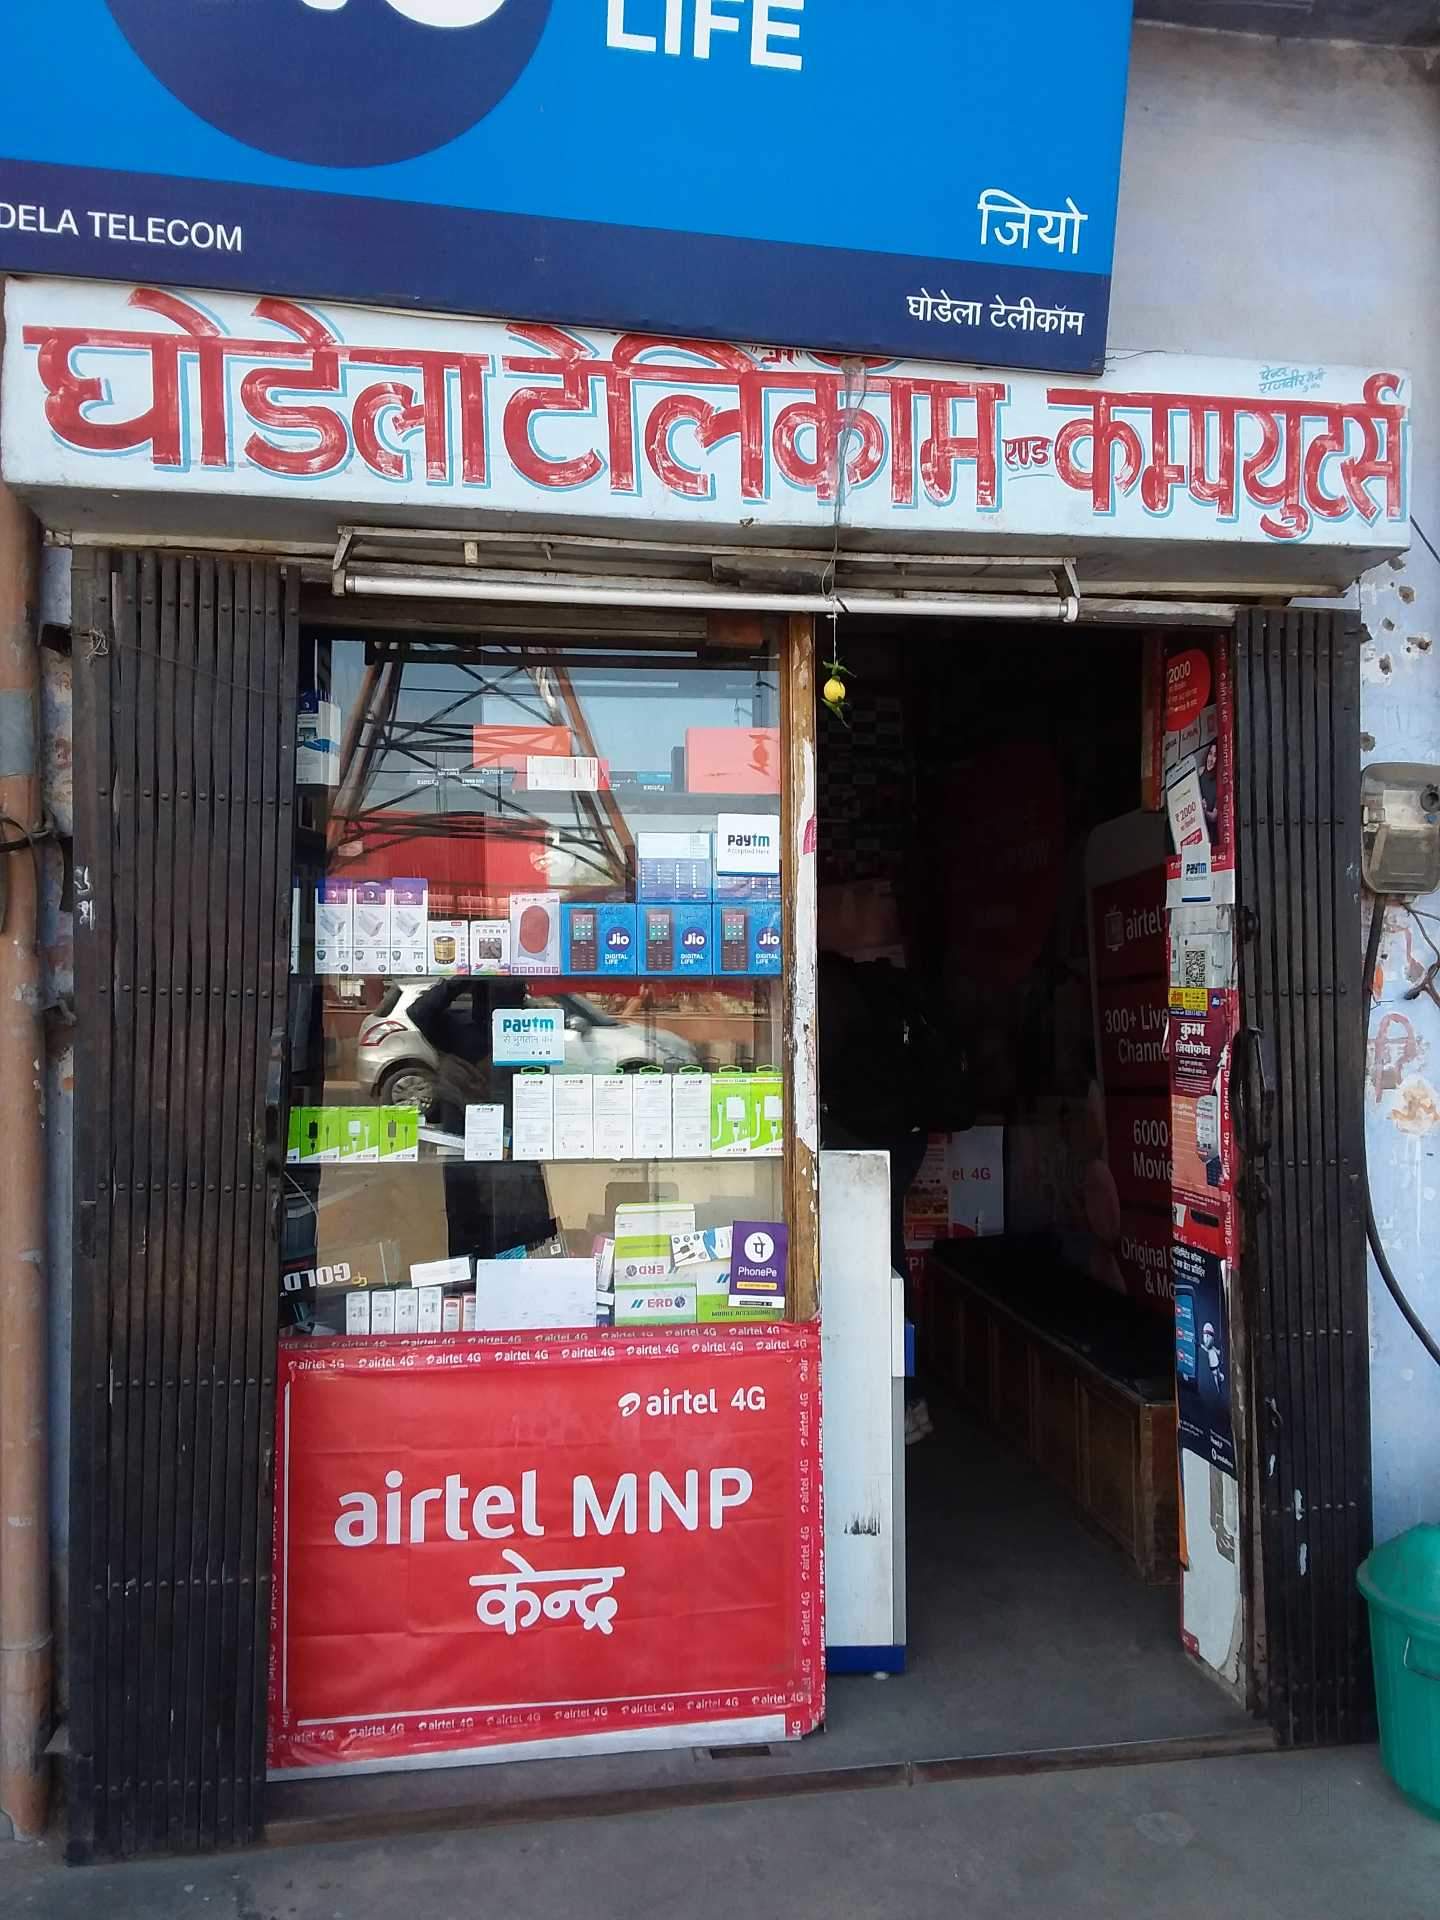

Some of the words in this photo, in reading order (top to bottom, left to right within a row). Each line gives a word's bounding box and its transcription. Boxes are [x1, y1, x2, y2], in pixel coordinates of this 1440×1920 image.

[605, 0, 803, 71] LIFE
[977, 188, 1089, 255] जियो
[87, 211, 242, 252] TELECOM
[906, 287, 983, 327] घोडेला
[989, 294, 1085, 336] टेलीकॉम
[1125, 905, 1162, 941] airtel
[608, 933, 630, 946] Jio
[684, 933, 705, 946] Jio
[759, 933, 780, 946] Jio
[1104, 1008, 1137, 1033] 300+
[1140, 1004, 1169, 1031] Live
[1132, 1119, 1168, 1147] 6000
[1120, 1236, 1168, 1270] Original
[284, 1262, 351, 1291] GOLD
[639, 1265, 664, 1275] ERD
[737, 1266, 777, 1278] PhonePe
[647, 1298, 673, 1309] ERD
[738, 1327, 764, 1336] airtel
[766, 1325, 780, 1335] 4G
[636, 1344, 662, 1355] airtel
[664, 1343, 680, 1354] 4G
[700, 1342, 727, 1353] airtel
[728, 1341, 744, 1352] 4G
[764, 1340, 790, 1351] airtel
[792, 1338, 808, 1350] 4G
[435, 1353, 463, 1365] airtel
[466, 1352, 482, 1363] 4G
[503, 1350, 531, 1362] airtel
[533, 1350, 549, 1361] 4G
[571, 1346, 598, 1358] airtel
[600, 1346, 615, 1357] 4G
[368, 1357, 396, 1369] airtel
[399, 1356, 415, 1367] 4G
[645, 1387, 719, 1417] airtel
[730, 1387, 767, 1412] 4G
[800, 1391, 809, 1407] 4G
[800, 1410, 809, 1437] airtel
[800, 1458, 809, 1473] 4G
[800, 1479, 809, 1504] airtel
[333, 1468, 545, 1548] airtel
[571, 1466, 754, 1538] MNP
[800, 1526, 810, 1540] 4G
[800, 1544, 810, 1571] airtel
[468, 1549, 626, 1636] केन्द्र
[801, 1591, 811, 1606] 4G
[801, 1610, 811, 1637] airtel
[695, 1699, 721, 1710] airtel
[725, 1697, 740, 1707] 4G
[761, 1694, 786, 1705] airtel
[790, 1692, 805, 1704] 4G
[564, 1709, 590, 1720] airtel
[630, 1704, 657, 1714] airtel
[359, 1724, 386, 1737] airtel
[428, 1719, 455, 1730] airtel
[791, 1720, 801, 1737] 4G
